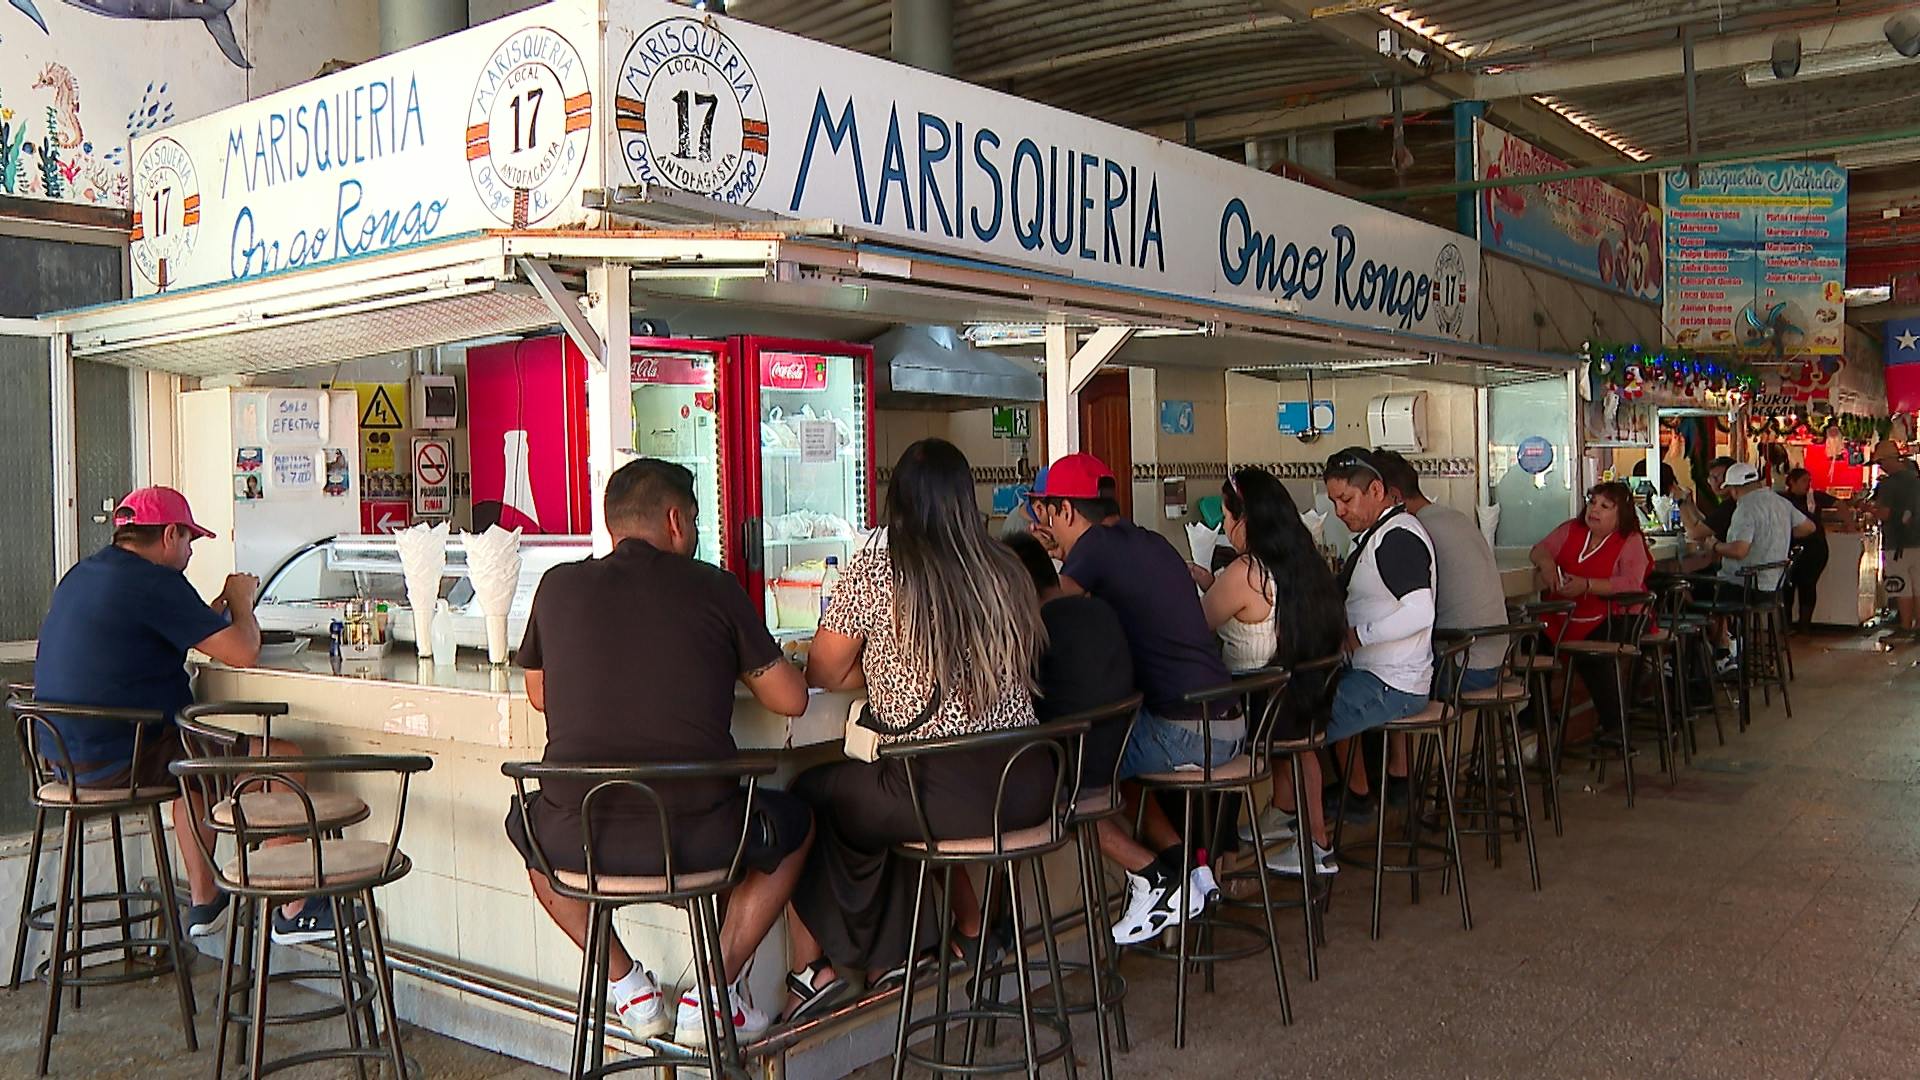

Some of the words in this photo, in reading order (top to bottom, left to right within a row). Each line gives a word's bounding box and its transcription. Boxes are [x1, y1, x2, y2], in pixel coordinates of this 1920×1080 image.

[477, 33, 574, 115] MARISQUERIA
[508, 66, 540, 90] LOCAL
[626, 25, 754, 104] MARISQUERIA
[667, 58, 708, 77] LOCAL
[222, 70, 424, 200] MARISQUERIA
[510, 87, 544, 155] 17
[672, 89, 719, 163] 17
[478, 166, 513, 211] Ongo
[500, 141, 560, 187] ANTOFAGASTA
[789, 86, 1166, 273] MARISQUERIA
[1768, 166, 1845, 193] Nathalie
[152, 186, 172, 238] 17
[231, 205, 330, 280] Ongo
[334, 178, 449, 260] Rongo
[1219, 197, 1329, 301] Ongo
[1331, 223, 1433, 331] Rongo
[1445, 274, 1457, 307] 17
